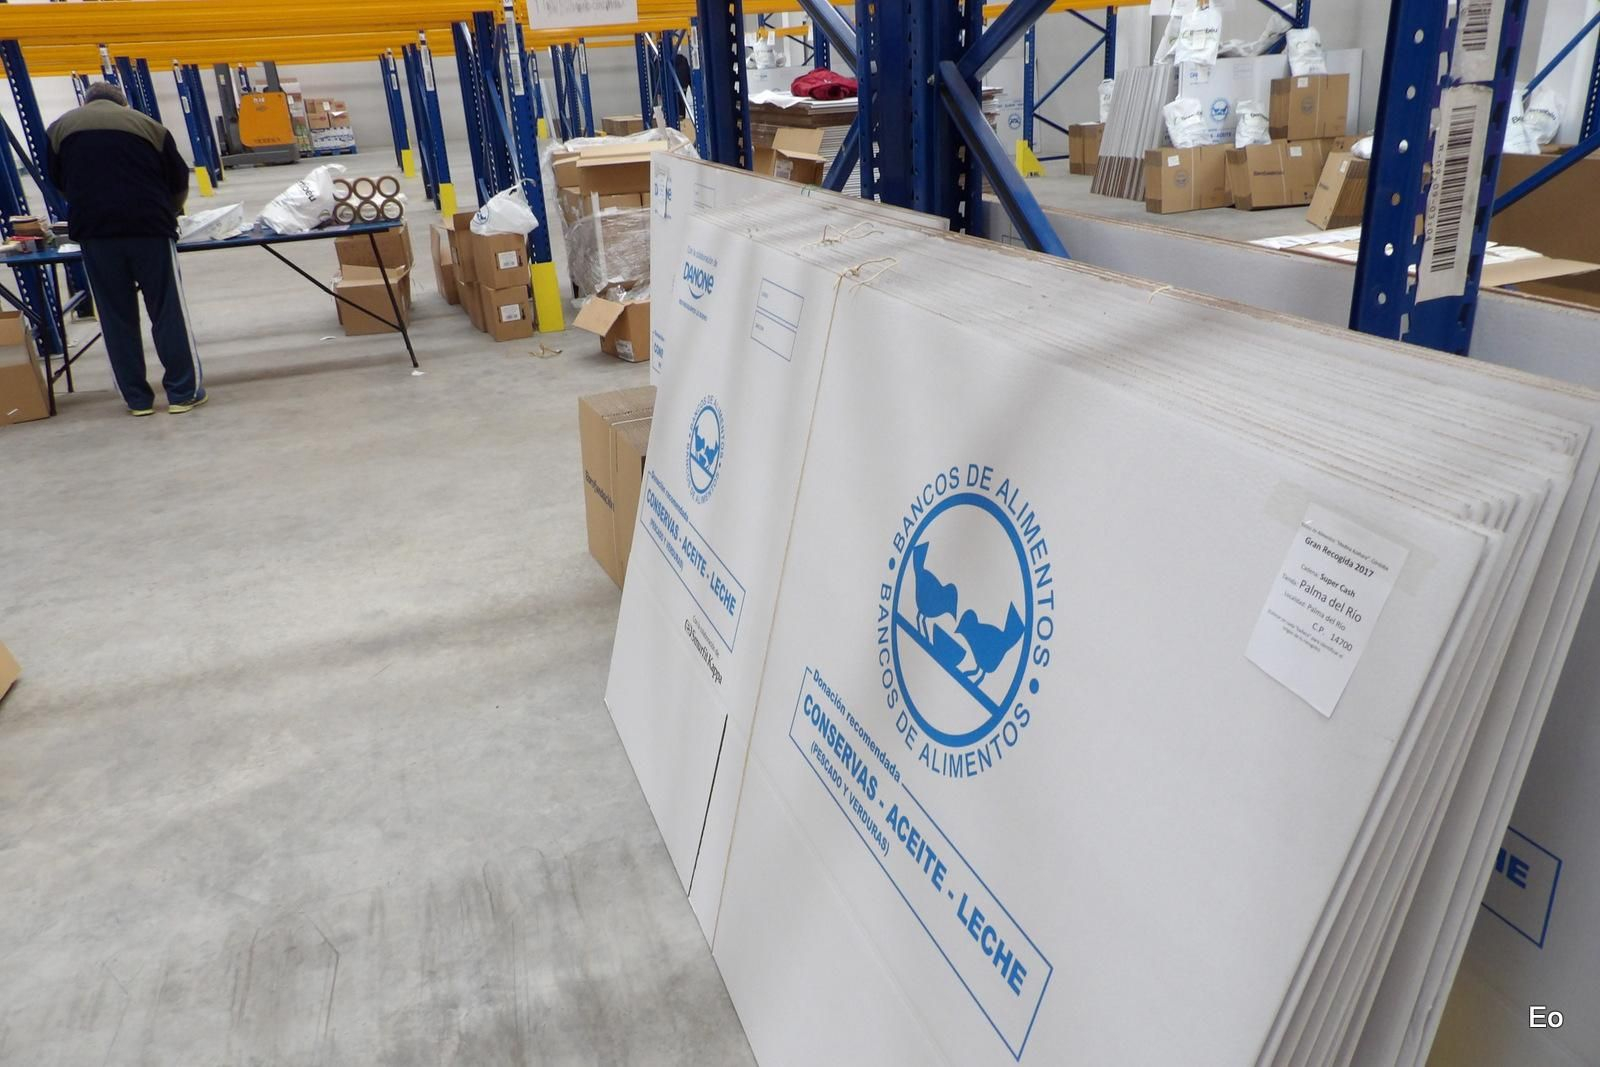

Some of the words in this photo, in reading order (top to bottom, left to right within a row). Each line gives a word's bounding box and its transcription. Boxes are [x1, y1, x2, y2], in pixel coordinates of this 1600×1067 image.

[683, 261, 715, 295] DANONE
[646, 488, 680, 541] CONSERVAS
[681, 536, 707, 578] ACEITE
[709, 571, 737, 617] LECHE
[892, 466, 960, 554] BANCOS
[966, 463, 994, 492] DE
[995, 478, 1055, 669] ALIMENTOS
[1304, 536, 1322, 551] Gran
[1322, 545, 1354, 568] Recogida
[1354, 563, 1375, 578] 2017
[1319, 573, 1340, 589] Super
[1339, 584, 1356, 599] Cash
[1299, 579, 1327, 603] Palma
[1328, 596, 1344, 612] del
[1344, 606, 1362, 624] Río
[1307, 602, 1325, 619] Palma
[1325, 613, 1336, 626] del
[877, 582, 898, 710] BANCOS
[895, 709, 921, 751] DE
[918, 701, 1031, 779] ALIMENTOS
[1330, 633, 1354, 652] 14700
[812, 668, 847, 716] Donación
[845, 711, 902, 784] recomendada
[810, 740, 844, 790] (PESCADO
[842, 783, 850, 797] Y
[848, 792, 891, 858] VERDURAS)
[803, 693, 879, 801] CONSERVAS
[886, 802, 948, 893] ACEITE
[956, 892, 1028, 997] LECHE
